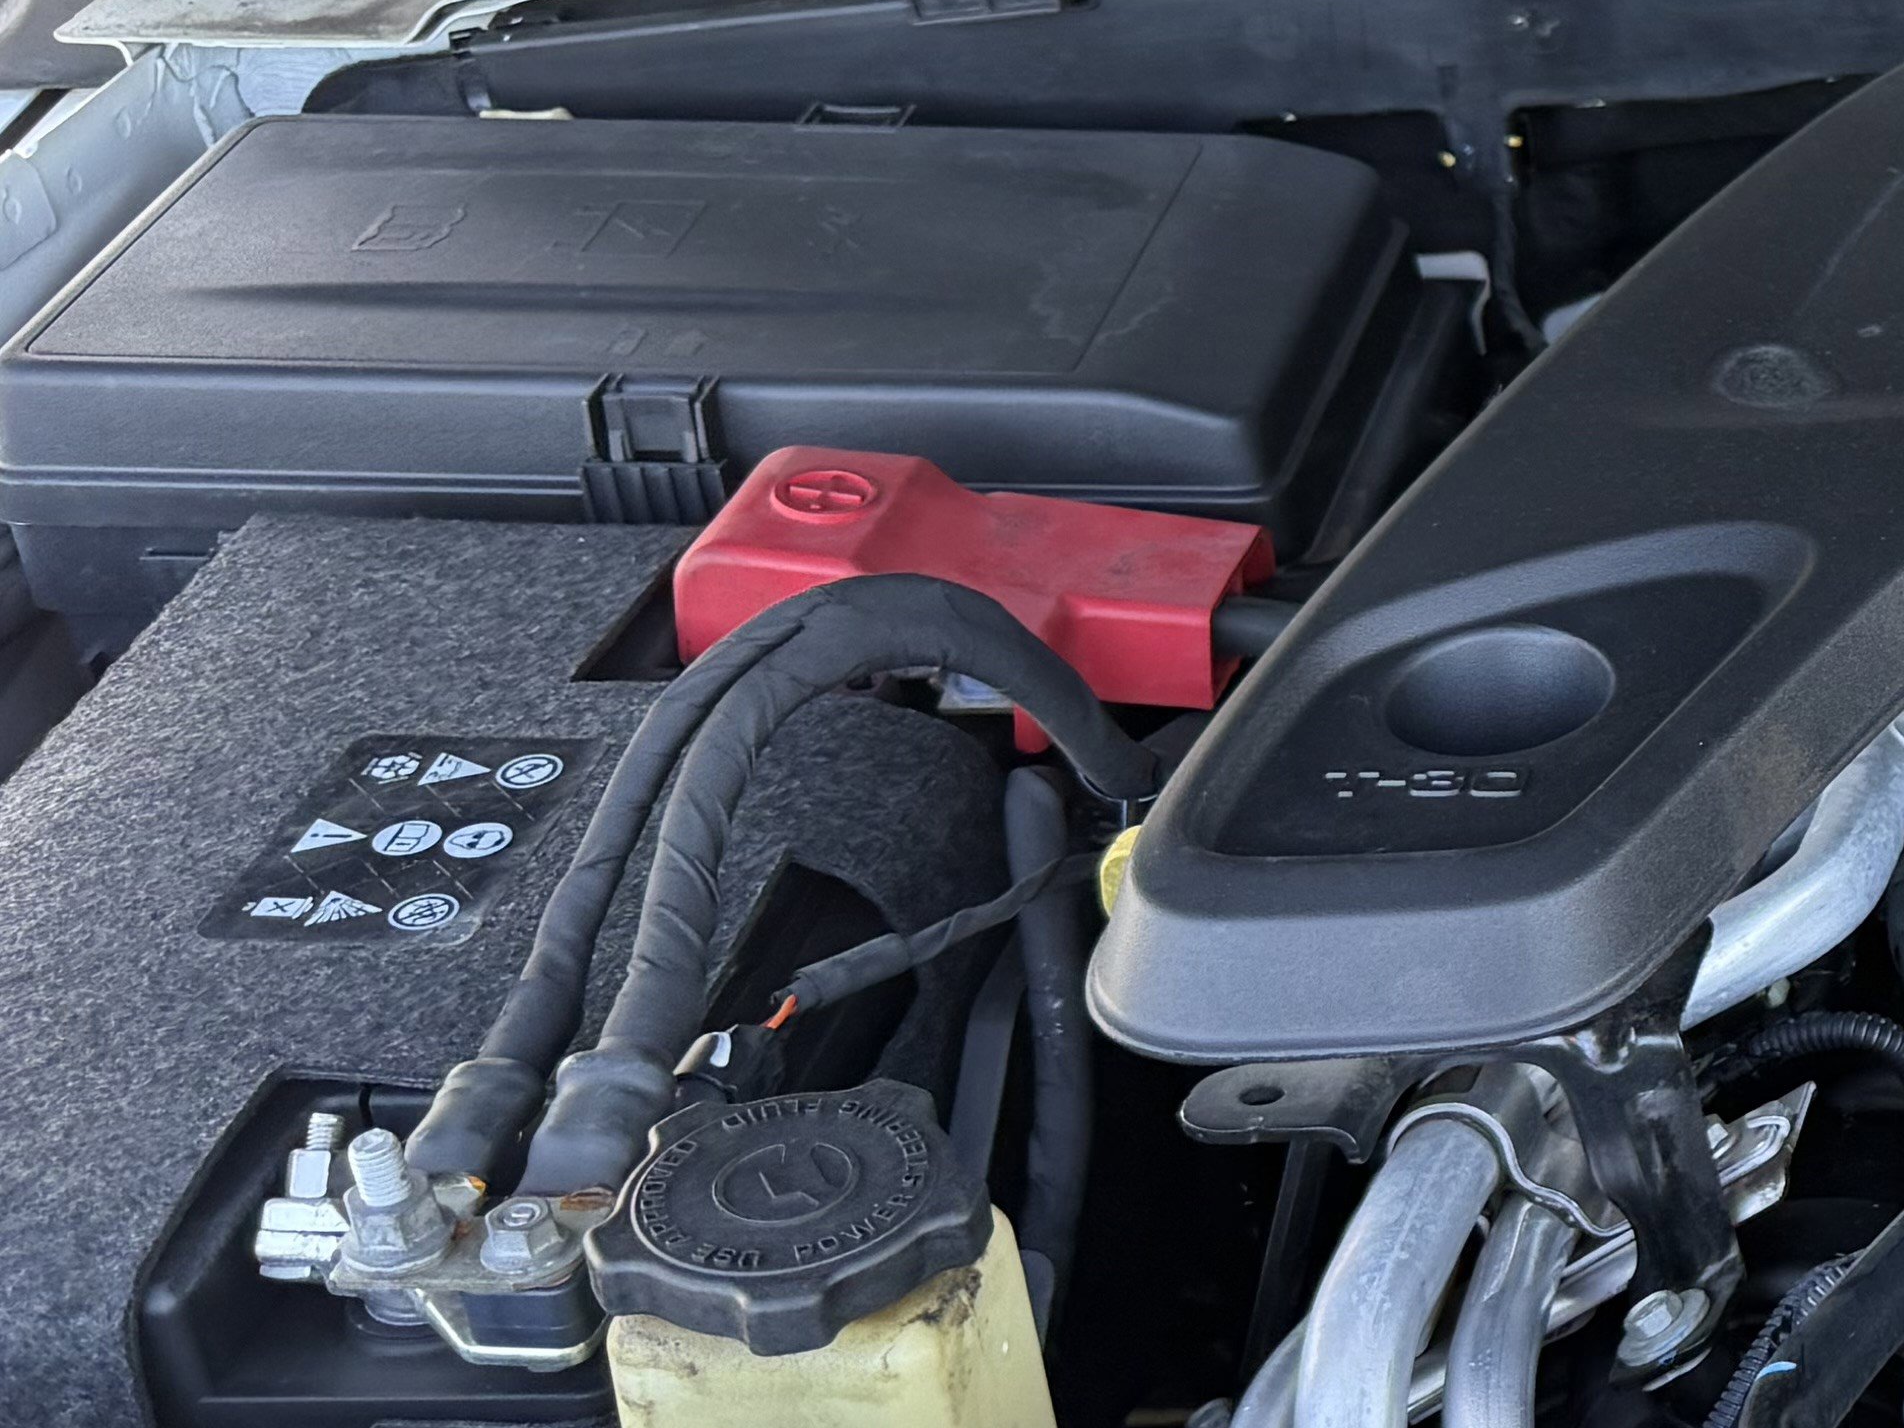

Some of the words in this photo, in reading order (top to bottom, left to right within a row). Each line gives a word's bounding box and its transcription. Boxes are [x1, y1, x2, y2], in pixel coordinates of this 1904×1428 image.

[720, 1097, 823, 1133] FLUID
[837, 1098, 930, 1194] STEERING
[640, 1138, 699, 1249] APPROVED
[793, 1192, 912, 1266] POWER
[690, 1241, 761, 1270] USE
